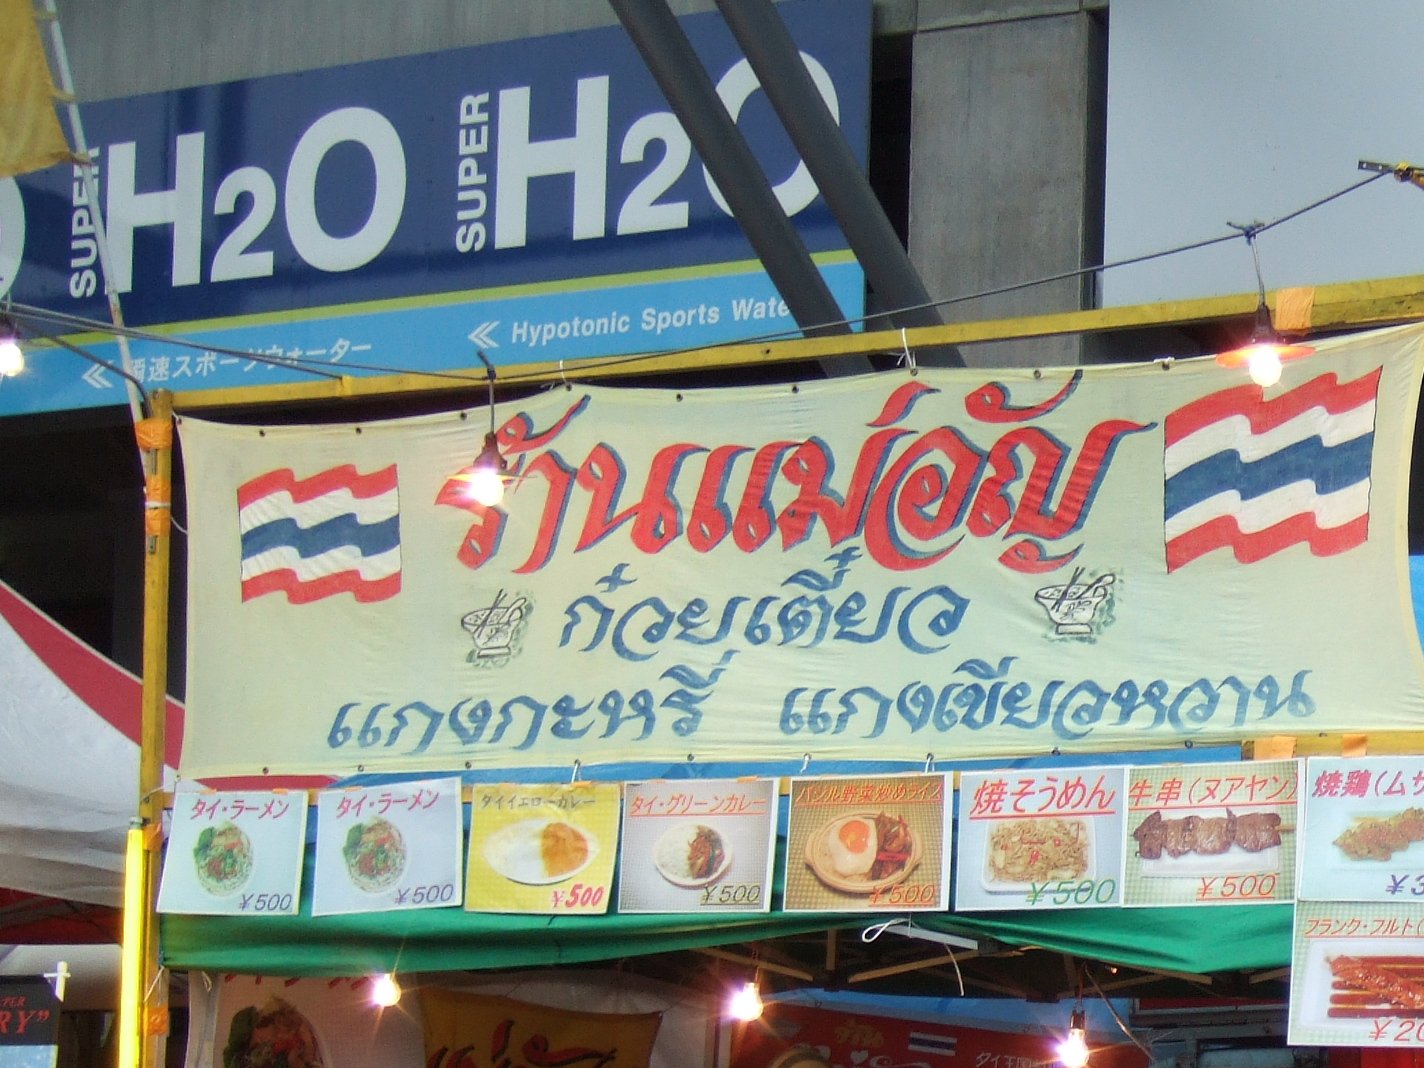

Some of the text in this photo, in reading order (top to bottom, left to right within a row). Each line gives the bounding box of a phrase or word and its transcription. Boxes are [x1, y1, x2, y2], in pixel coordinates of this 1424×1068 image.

[455, 91, 490, 253] SUPER
[107, 107, 407, 292] H2O
[511, 296, 791, 347] Hypotonic Sports Wate
[781, 656, 1318, 739] แกงเขียวหวาน
[395, 884, 454, 906] ¥500
[552, 883, 604, 908] ¥500
[701, 884, 761, 904] ¥500
[869, 883, 935, 905] ¥500
[1026, 878, 1116, 906] ¥500
[1196, 873, 1277, 899] ¥500
[239, 893, 292, 913] ¥500
